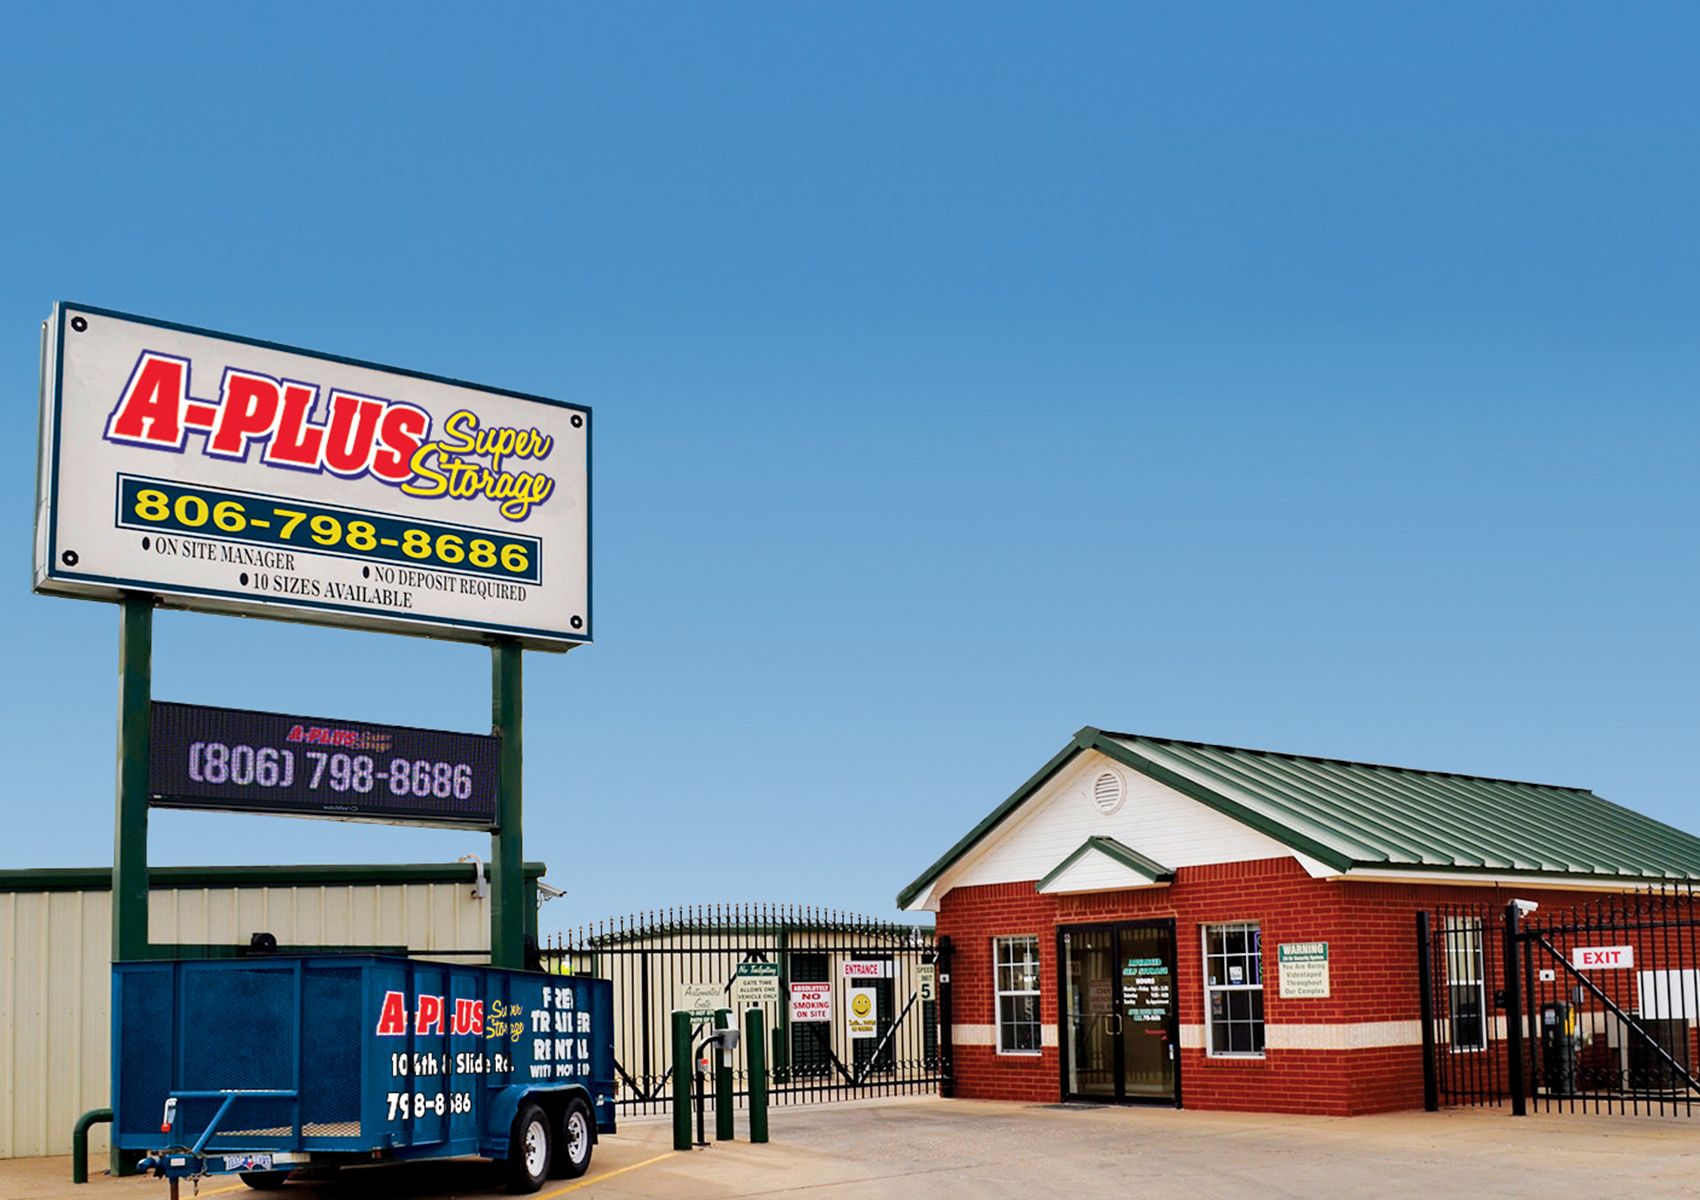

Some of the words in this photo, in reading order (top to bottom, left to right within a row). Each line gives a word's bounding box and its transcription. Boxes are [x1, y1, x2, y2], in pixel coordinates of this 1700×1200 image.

[105, 350, 432, 485] A-PLUS
[438, 409, 554, 472] Super
[400, 441, 555, 522] Storage
[133, 488, 530, 574] 806-798-8686
[155, 536, 178, 555] ON
[182, 540, 217, 563] SITE
[220, 545, 296, 571] MANAGER
[253, 572, 269, 590] 10
[273, 574, 321, 597] SIZES
[324, 582, 413, 609] AVAILABLE
[374, 565, 395, 585] NO
[398, 569, 457, 593] DEPOSIT
[460, 578, 527, 602] REQUIRED
[286, 725, 358, 747] A-PLUS
[188, 741, 295, 788] (806)
[306, 751, 473, 800] 798-8686
[1283, 944, 1323, 955] WARNING
[1582, 951, 1622, 965] EXIT
[845, 964, 878, 975] ENTRANCE
[684, 985, 722, 997] Automated
[920, 983, 931, 999] 5
[1297, 987, 1325, 995] Complex
[694, 998, 712, 1009] Gate
[793, 1001, 829, 1009] SMOKING
[796, 1010, 808, 1018] ON
